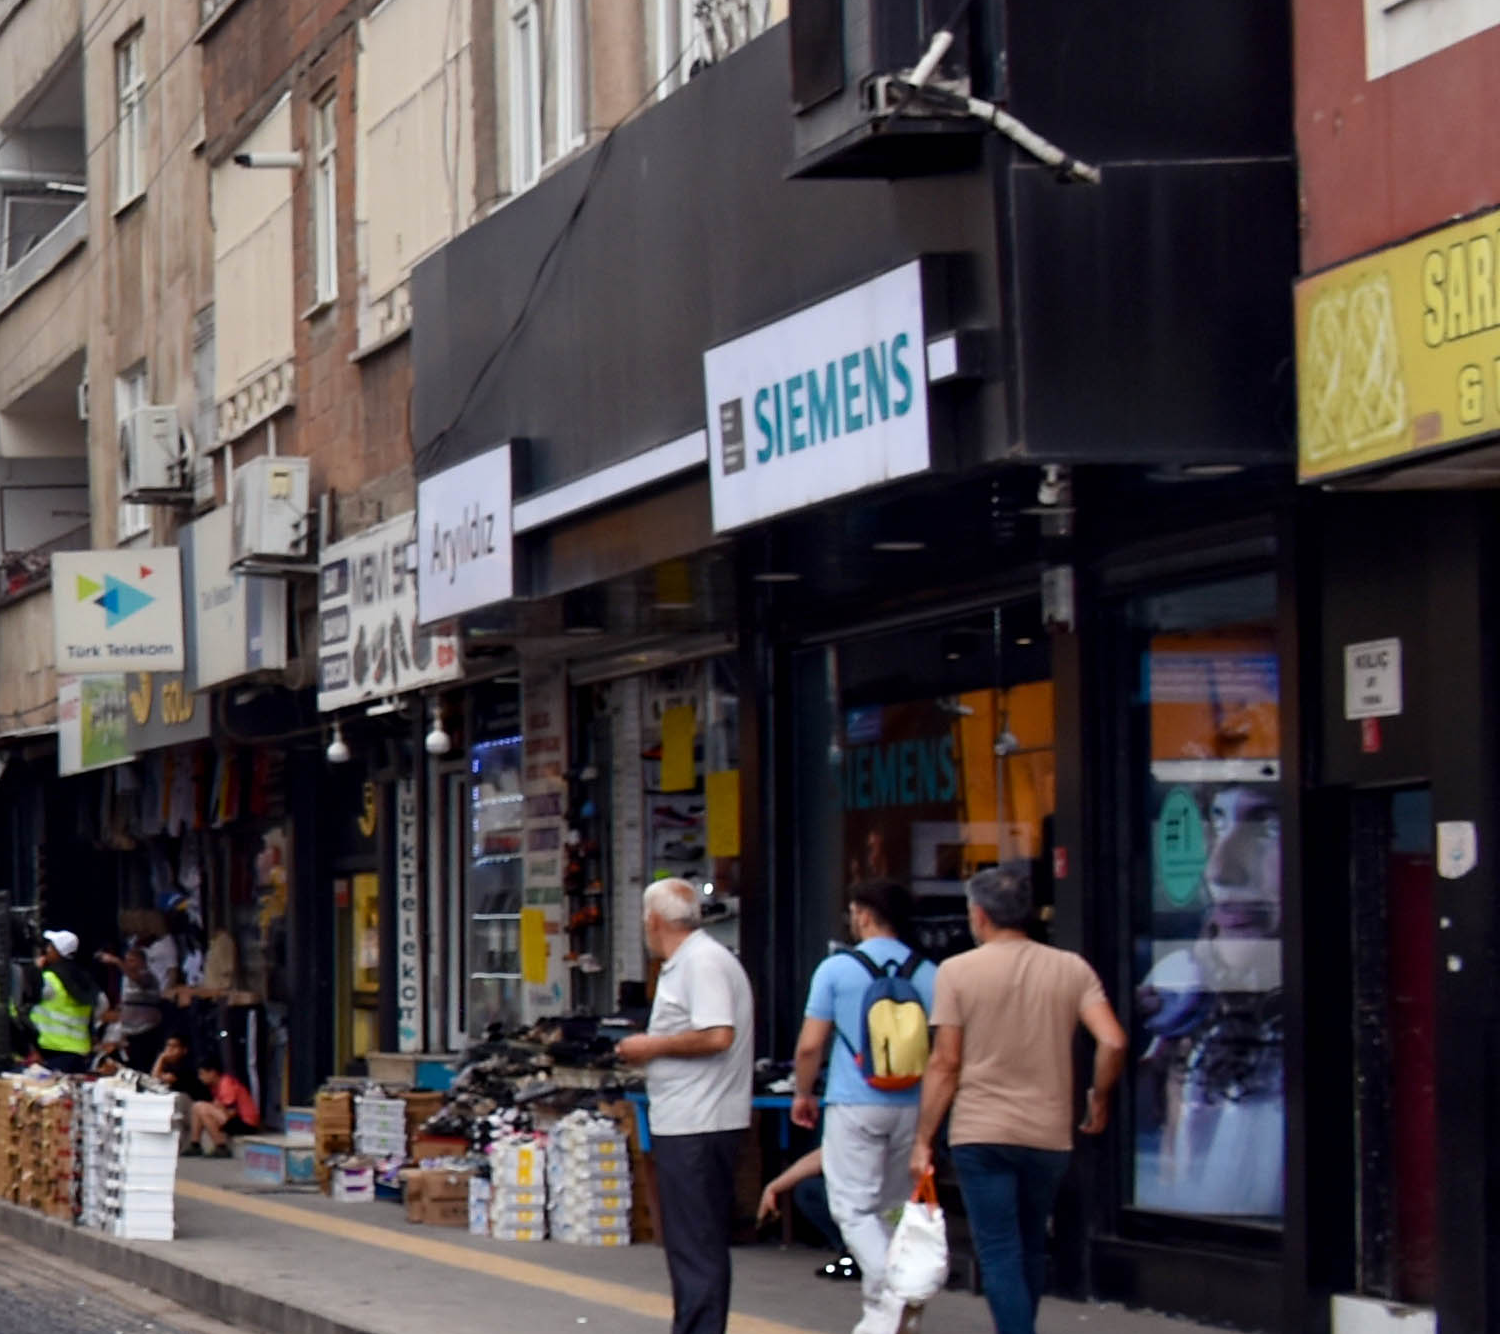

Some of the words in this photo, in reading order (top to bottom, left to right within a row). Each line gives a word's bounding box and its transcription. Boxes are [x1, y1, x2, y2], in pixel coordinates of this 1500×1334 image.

[1423, 227, 1500, 348] SAR
[754, 332, 913, 464] SIEMENS
[66, 644, 101, 659] Türk
[106, 643, 174, 657] Telekom
